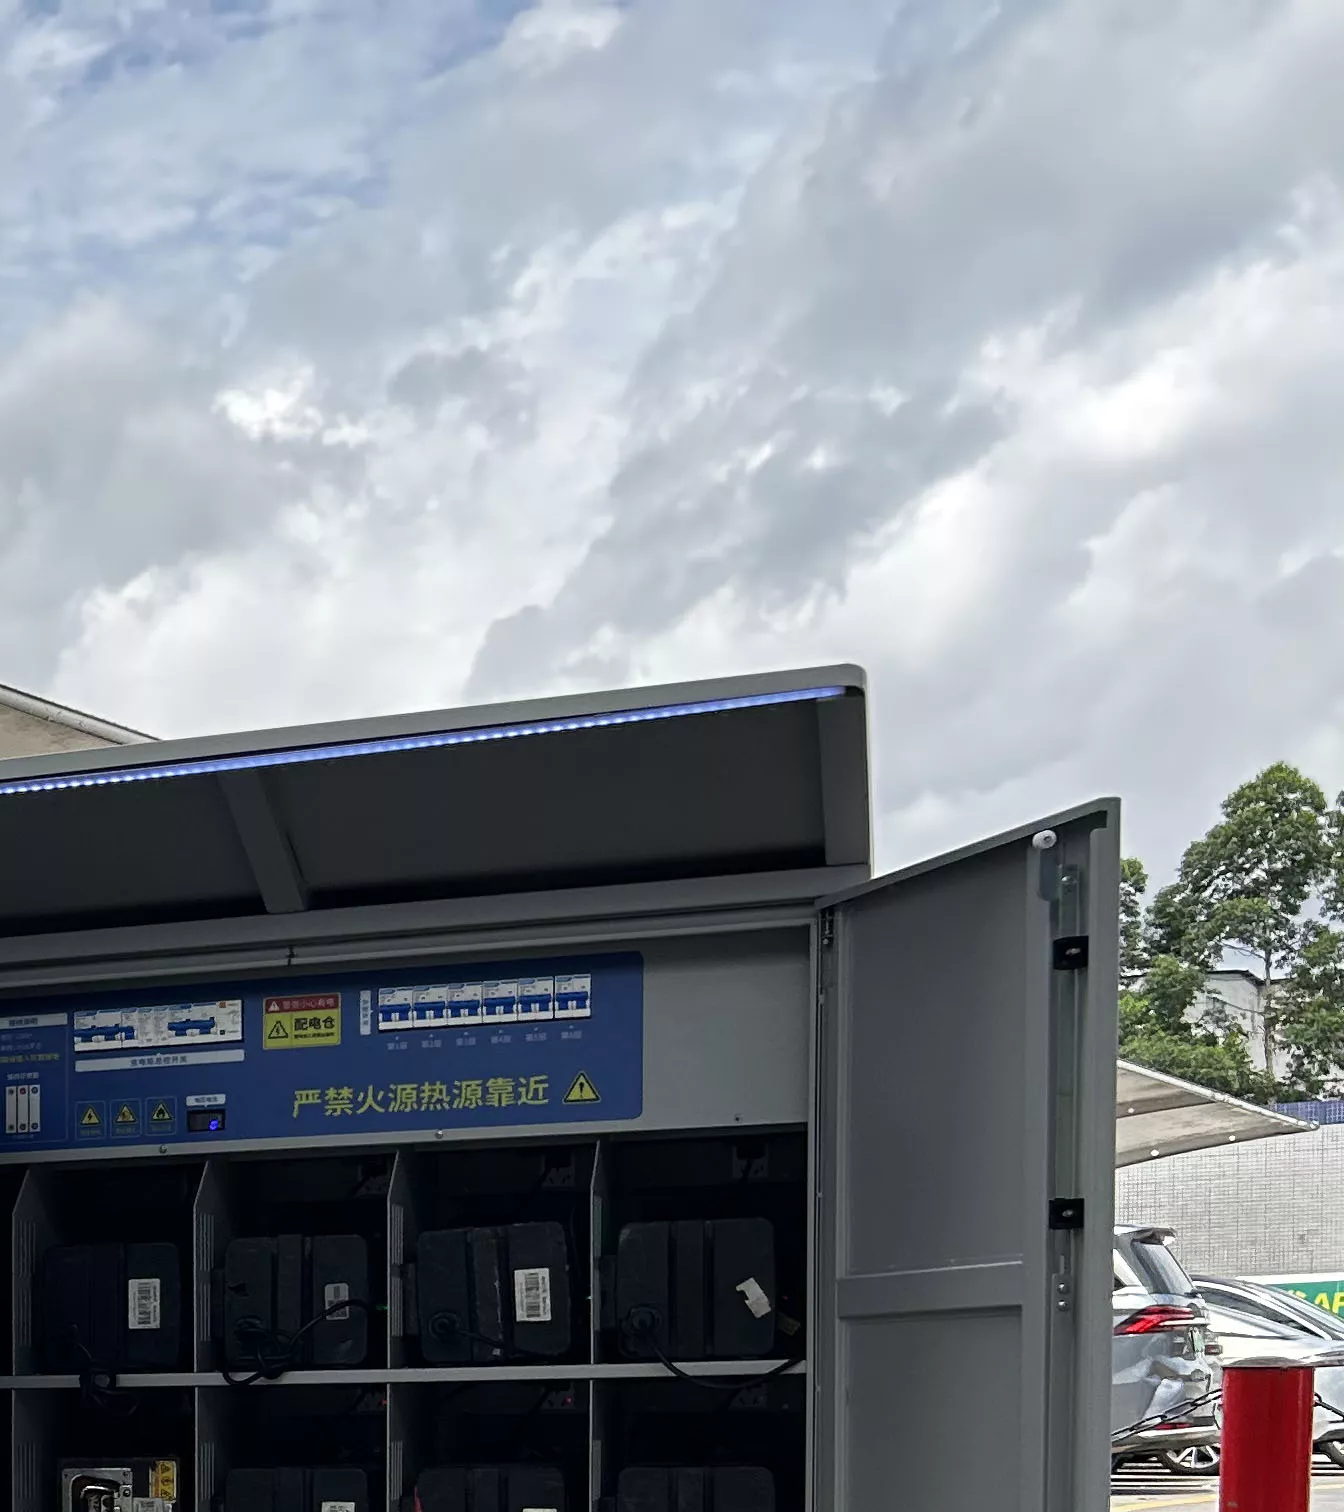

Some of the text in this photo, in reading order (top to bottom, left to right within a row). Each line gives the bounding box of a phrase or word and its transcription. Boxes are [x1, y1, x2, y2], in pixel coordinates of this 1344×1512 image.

[294, 1016, 335, 1031] 配电仓
[292, 1075, 550, 1118] 严禁火源热源靠近
